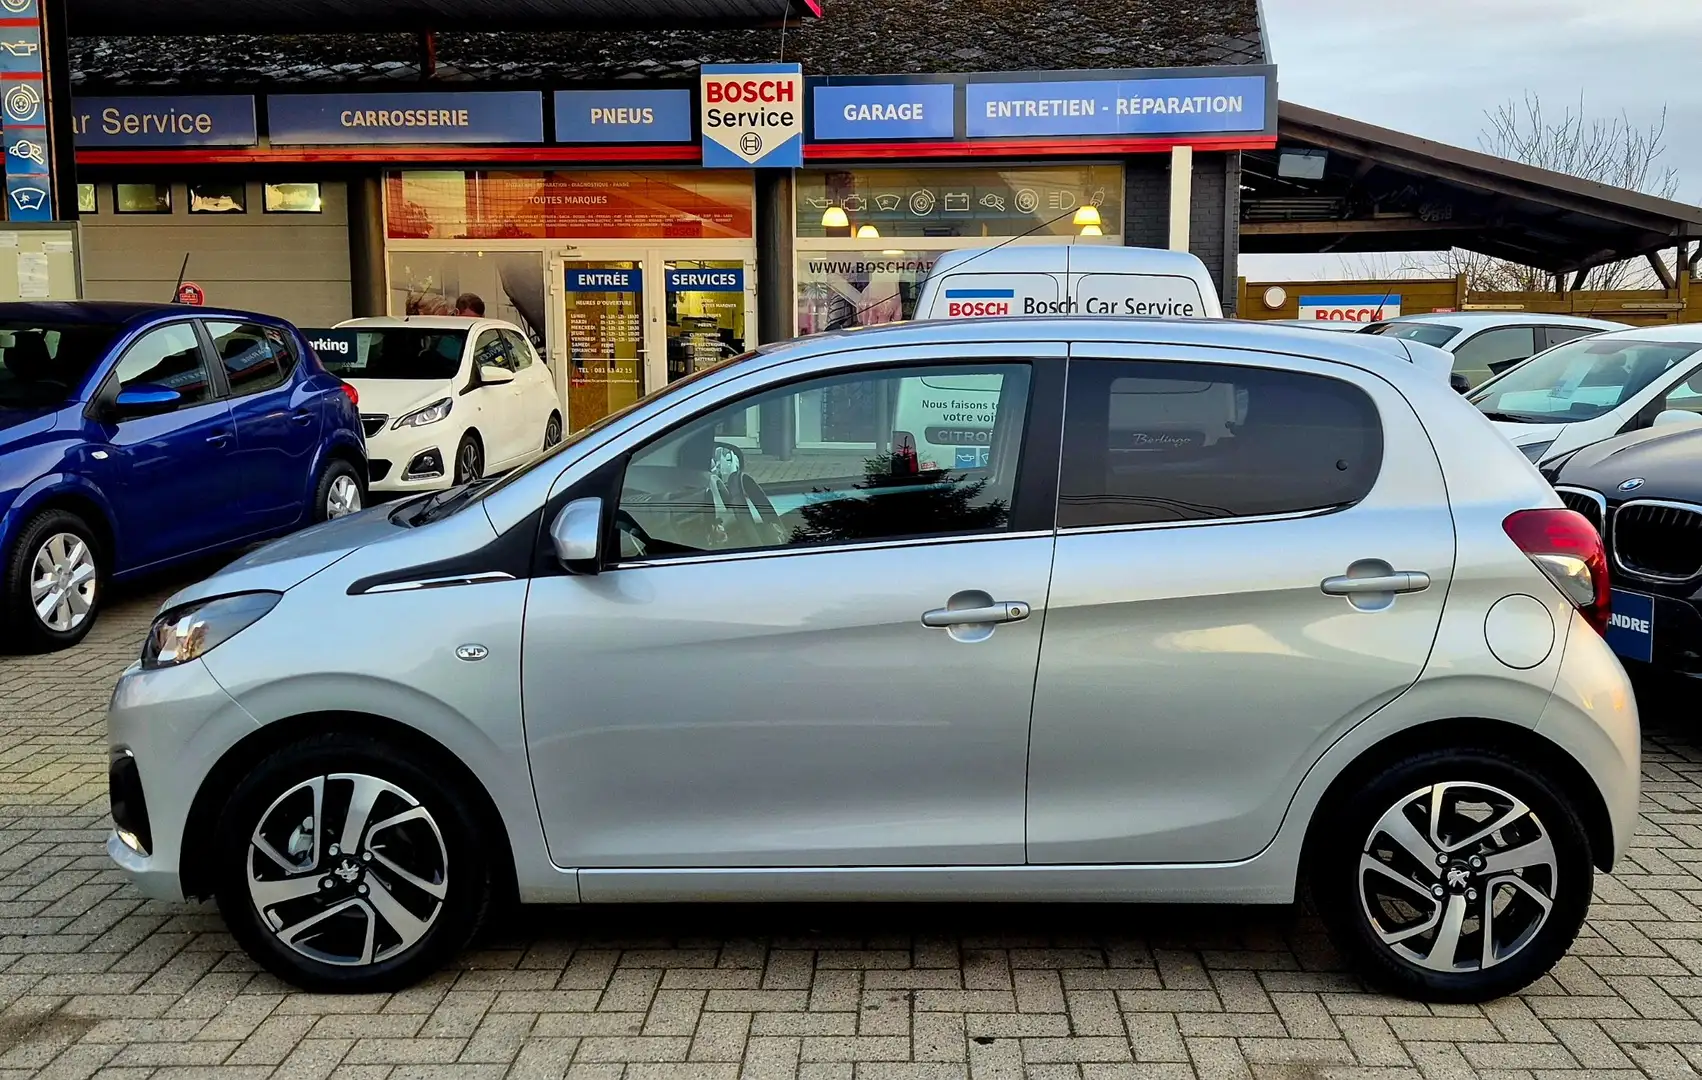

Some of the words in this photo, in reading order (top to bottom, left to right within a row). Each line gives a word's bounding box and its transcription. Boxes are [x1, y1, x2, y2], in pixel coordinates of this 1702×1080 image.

[707, 81, 793, 103] BOSCH
[843, 103, 923, 121] GARAGE
[986, 99, 1095, 118] ENTRETIEN
[1116, 94, 1243, 116] RÉPARATION
[102, 108, 212, 134] Service
[340, 109, 469, 127] CARROSSERIE
[591, 107, 654, 124] PNEUS
[707, 107, 794, 128] Service
[528, 196, 562, 204] TOUTES
[564, 196, 608, 205] MARQUES
[578, 271, 629, 286] ENTRÉE
[672, 273, 736, 286] SERVICES
[949, 303, 1008, 317] BOSCH
[1024, 296, 1078, 315] Bosch
[1086, 298, 1118, 315] Car
[1125, 298, 1193, 317] Service
[1316, 309, 1383, 321] BOSCH
[922, 400, 948, 408] Nous
[951, 400, 988, 409] faisons
[943, 413, 973, 421] votre
[1133, 433, 1191, 447] Berlingo
[1609, 613, 1650, 634] NDRE
